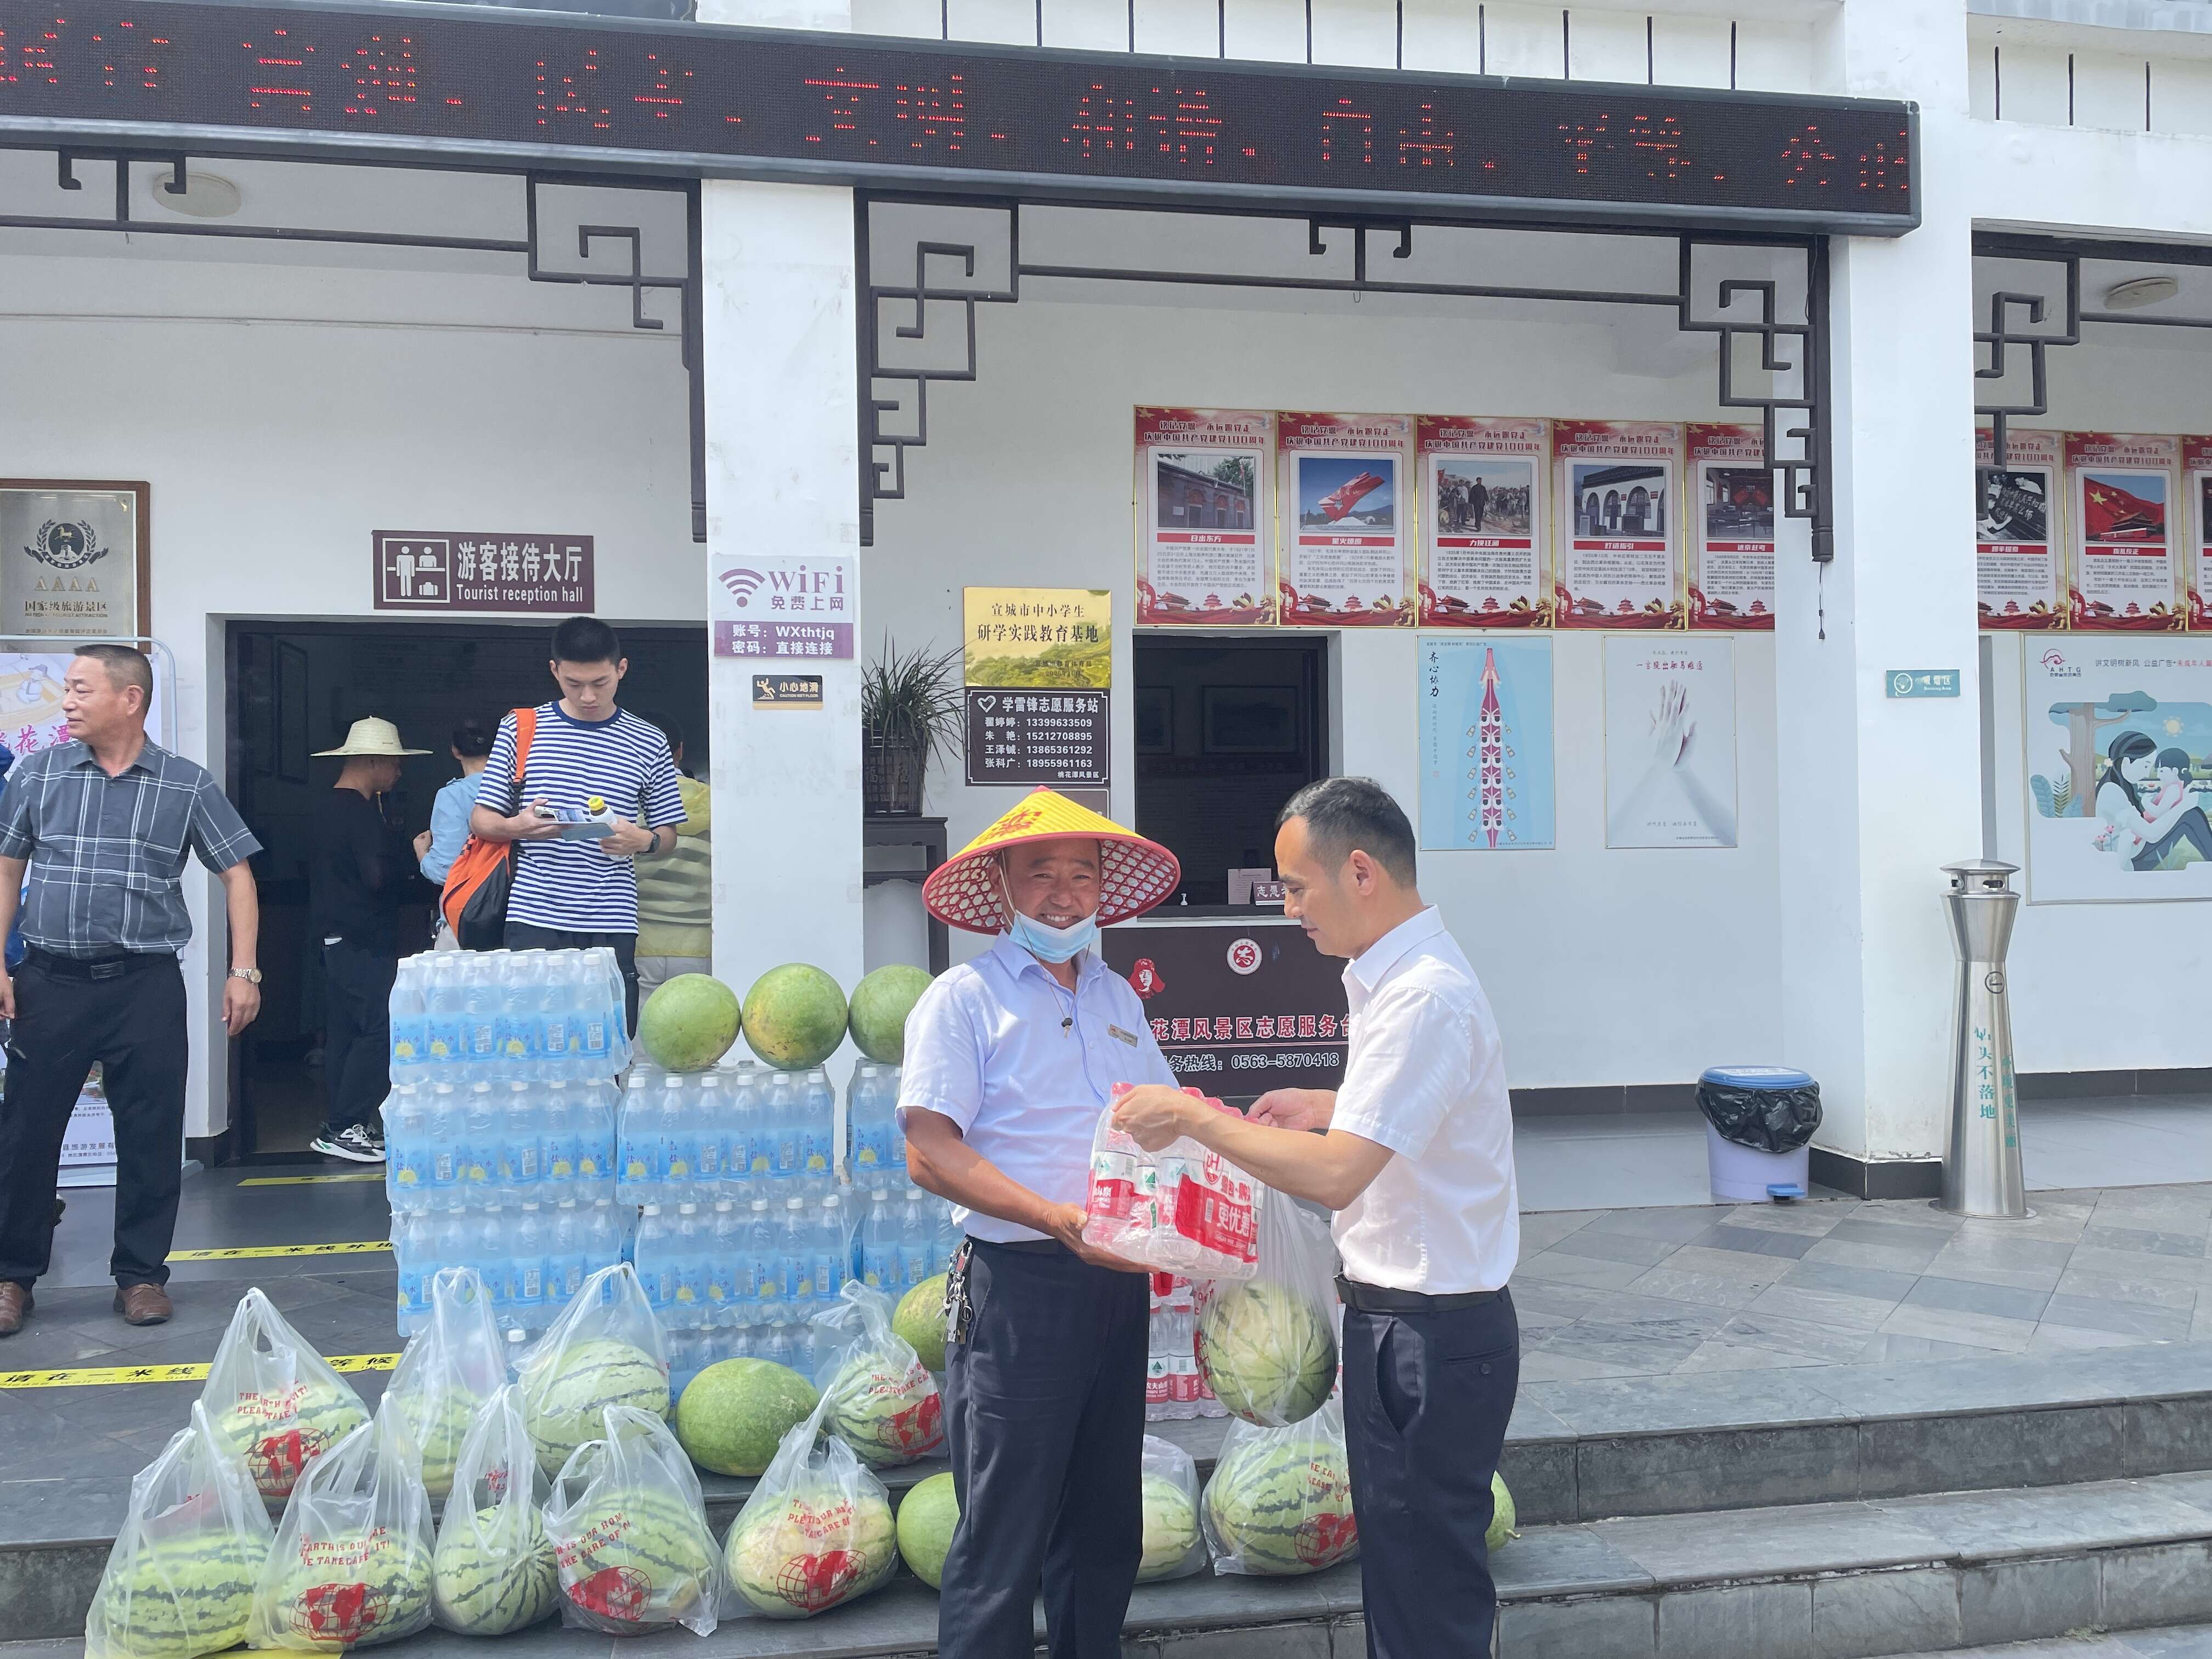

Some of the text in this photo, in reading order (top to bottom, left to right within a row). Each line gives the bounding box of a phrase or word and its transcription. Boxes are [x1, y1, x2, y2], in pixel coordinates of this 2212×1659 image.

[457, 541, 582, 583] 游客接待大厅
[768, 565, 845, 594] WiFi
[456, 584, 583, 605] Tourist reception hall
[25, 601, 107, 612] 国家级旅游景区
[771, 596, 843, 611] 免费上网
[991, 603, 1085, 618] 宣城市中小学生
[732, 624, 834, 640] 账号： WXthtjq
[977, 624, 1099, 644] 研学实践教育基地
[732, 641, 833, 655] 密码： 直接连接
[1637, 659, 1703, 671] 一言既出驷马难追
[2095, 659, 2140, 667] 讲文明树新风
[1429, 651, 1440, 697] 齐心协力
[779, 681, 819, 693] 小心地滑
[1002, 697, 1099, 714] 学雷锋志愿服务站
[1026, 718, 1092, 727] 13399633509
[985, 731, 995, 741] 朱
[1026, 732, 1092, 741] 15212708895
[1026, 746, 1092, 754] 13865361292
[1026, 759, 1092, 768] 18955961163
[1057, 771, 1099, 779] 桃花潭风景区
[1164, 1053, 1223, 1071] 务热线：
[1219, 1201, 1251, 1238] 更优惠
[239, 1392, 258, 1401] THE
[580, 1527, 598, 1544] OUR
[580, 1538, 606, 1559] CARE
